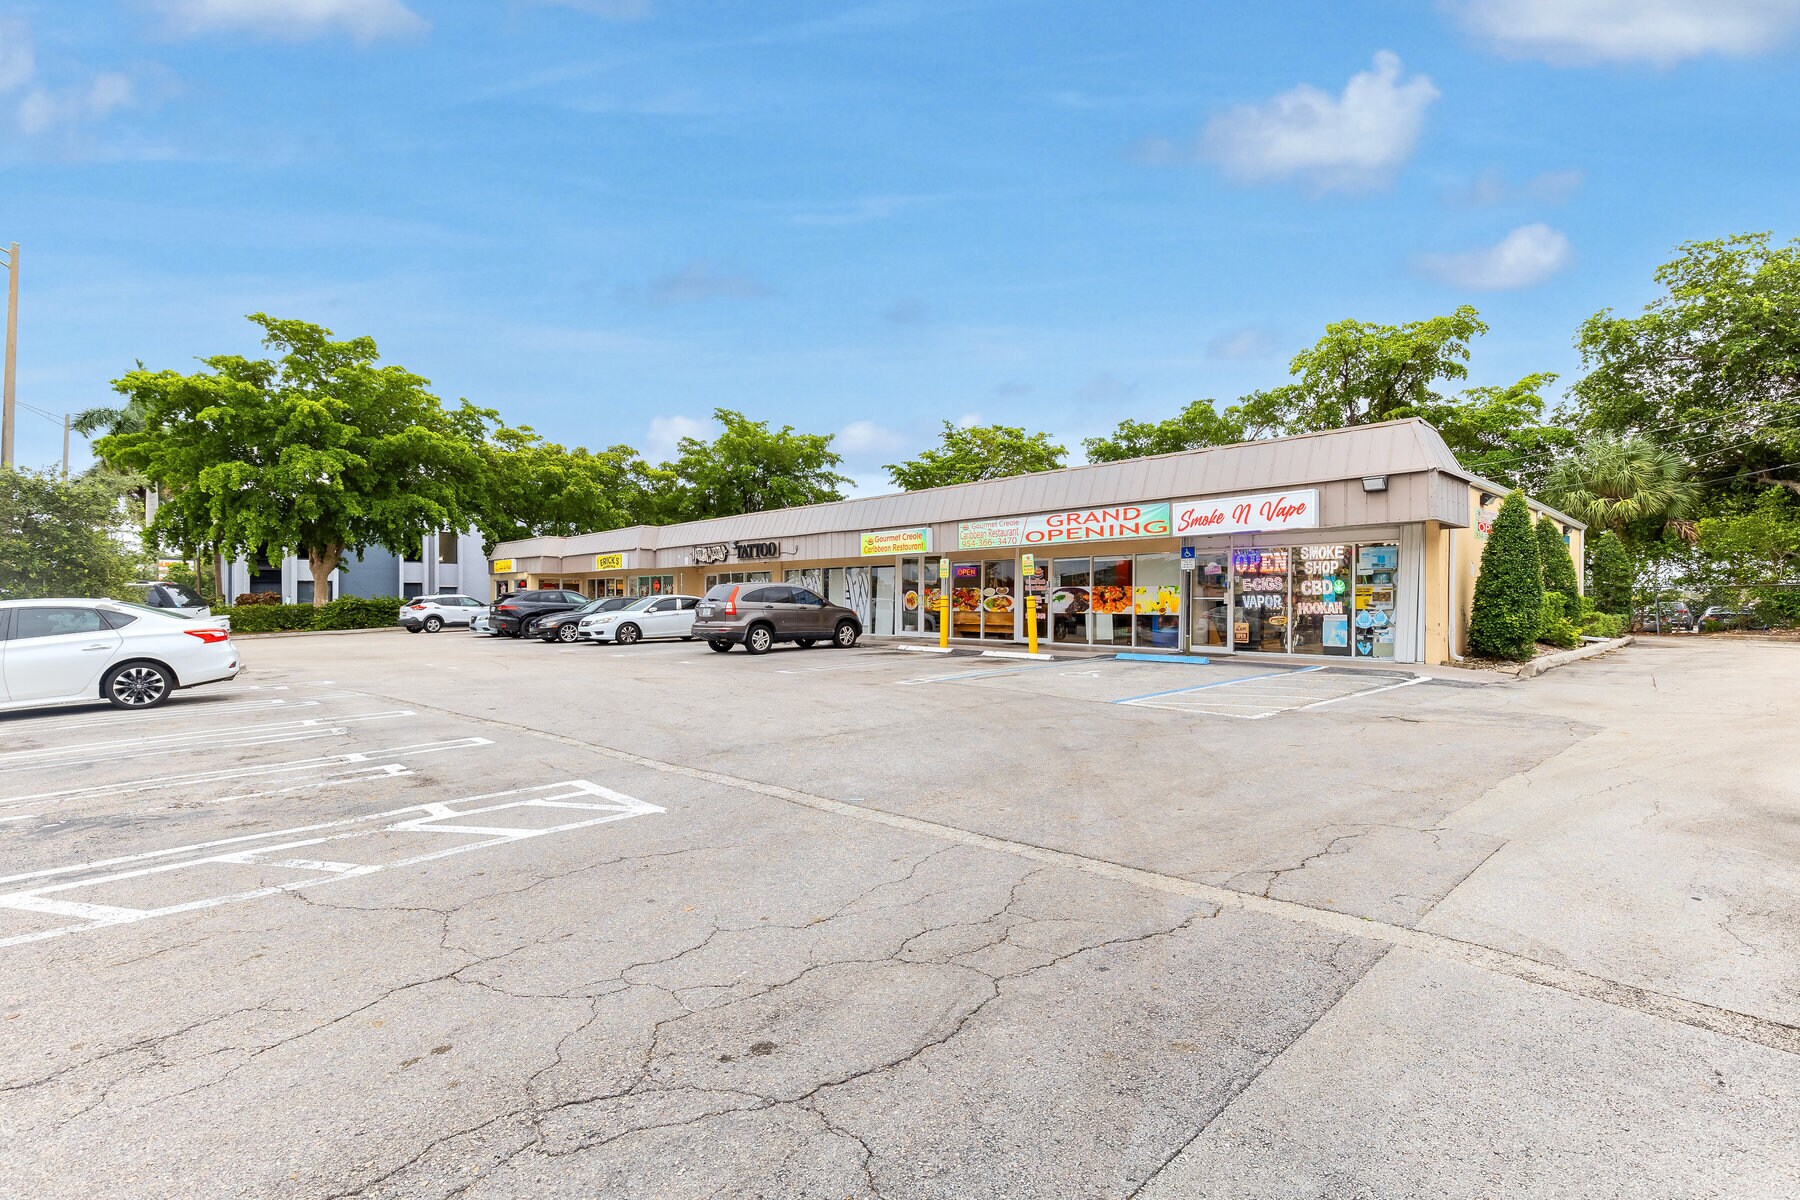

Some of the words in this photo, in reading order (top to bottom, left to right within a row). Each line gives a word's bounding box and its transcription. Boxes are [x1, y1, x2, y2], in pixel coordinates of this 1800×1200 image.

[1046, 507, 1141, 528] GRAND
[1177, 508, 1226, 532] Smoke
[1232, 503, 1252, 525] N
[1259, 496, 1307, 522] Vape
[971, 522, 998, 530] Gourmet
[999, 519, 1020, 528] Creole
[1025, 520, 1168, 543] OPENING
[874, 534, 901, 543] Gourmet
[902, 532, 923, 541] Creole
[960, 531, 987, 541] Caribbean
[988, 527, 1019, 538] Restaurant
[735, 541, 778, 559] TATTOO
[863, 545, 892, 554] Caribbean
[892, 541, 925, 551] Restaurant
[1300, 546, 1345, 560] SMOKE
[1234, 550, 1288, 573] OPEN
[1304, 560, 1339, 574] SHOP
[957, 567, 977, 576] OPEN
[1242, 576, 1283, 592] E-CIGS
[1301, 580, 1333, 596] CBD
[1242, 594, 1282, 609] VAPOR
[1298, 601, 1343, 615] HOOKAH
